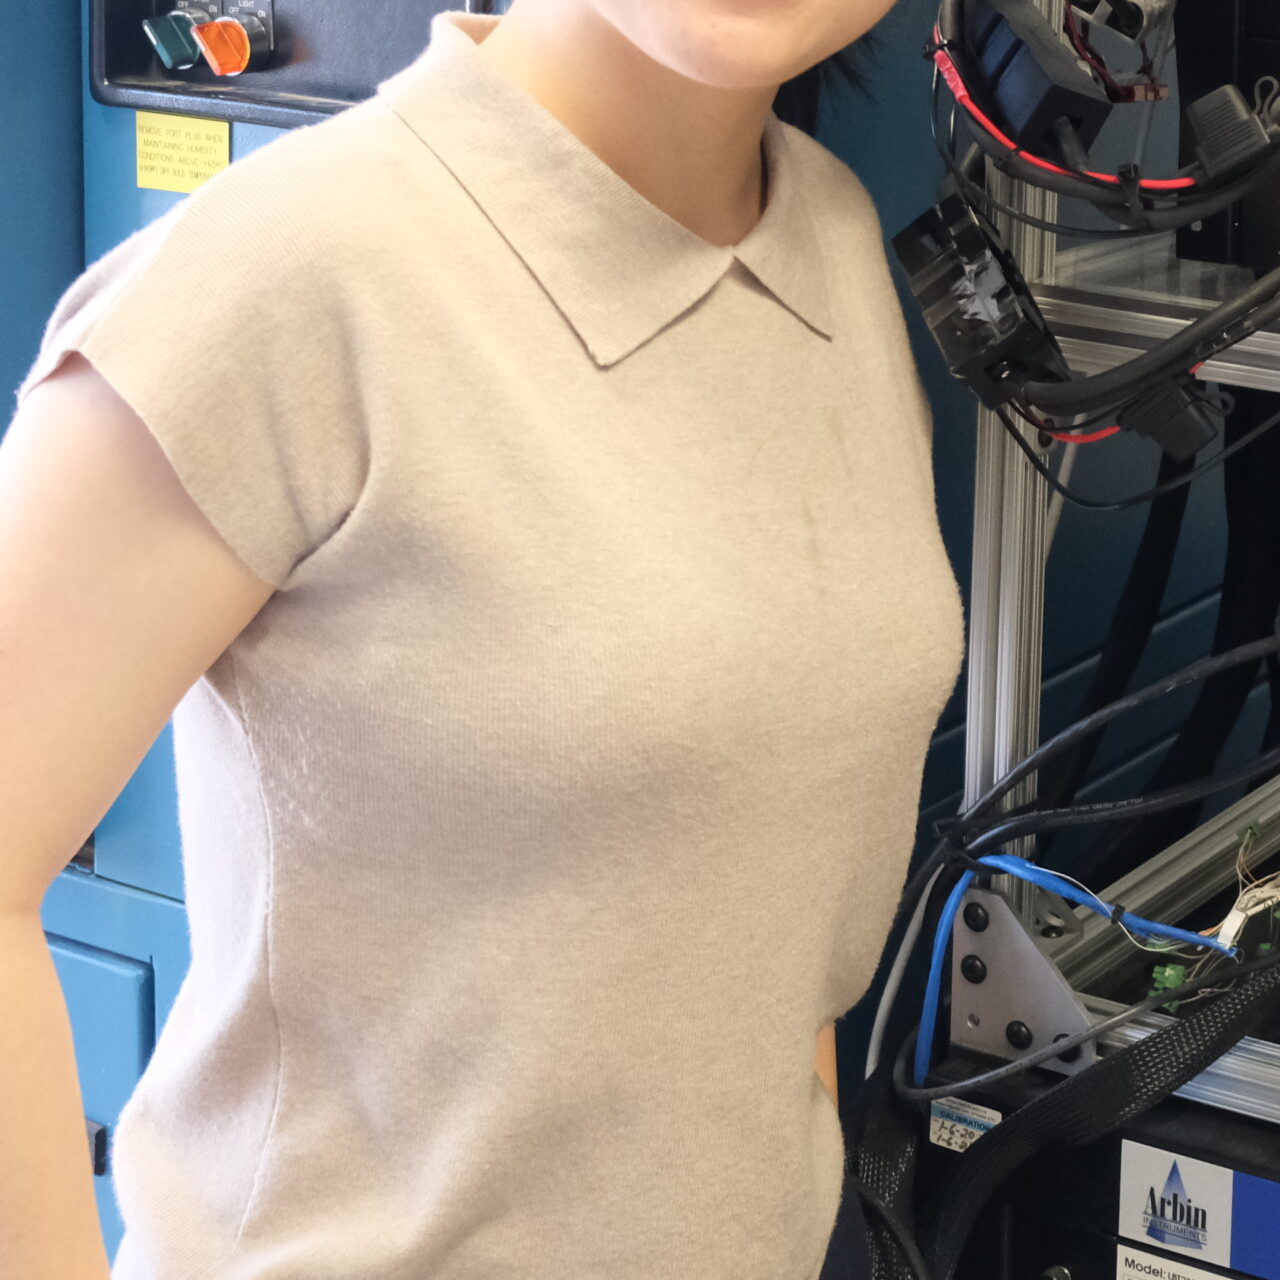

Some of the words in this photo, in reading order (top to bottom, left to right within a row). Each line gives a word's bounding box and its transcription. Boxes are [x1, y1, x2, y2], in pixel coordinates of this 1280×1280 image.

[178, 0, 189, 8] OFF
[209, 4, 218, 13] ON
[228, 6, 240, 14] OFF
[258, 10, 266, 18] ON
[238, 0, 254, 8] LIGHT
[1142, 1186, 1207, 1232] Arbin
[1142, 1216, 1207, 1242] INSTRUMENTS
[1124, 1257, 1167, 1280] Model:
